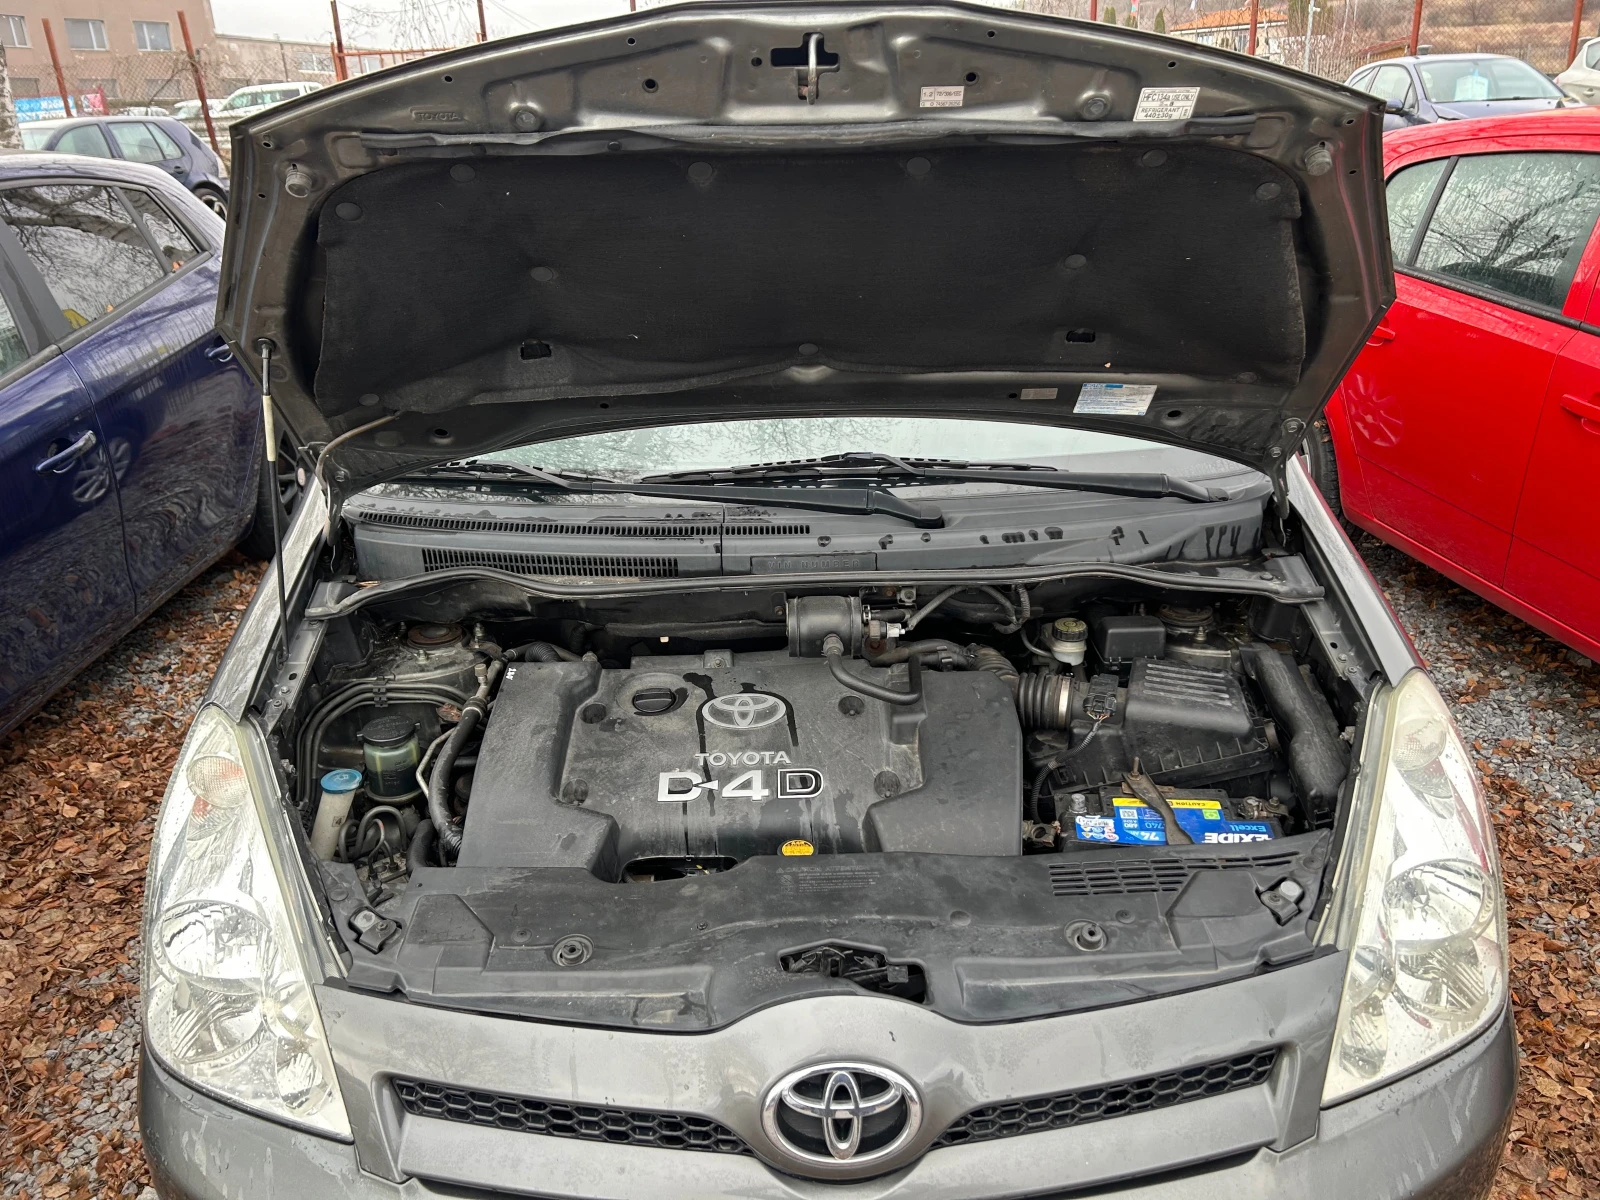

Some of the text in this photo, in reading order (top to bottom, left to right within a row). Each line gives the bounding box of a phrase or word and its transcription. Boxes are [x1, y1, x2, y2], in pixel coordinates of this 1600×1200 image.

[417, 112, 461, 121] TOYOTA
[767, 559, 860, 570] VIN NUMBER
[694, 750, 792, 767] TOYOTA
[1140, 831, 1160, 841] 74
[1204, 832, 1272, 844] EXIDE
